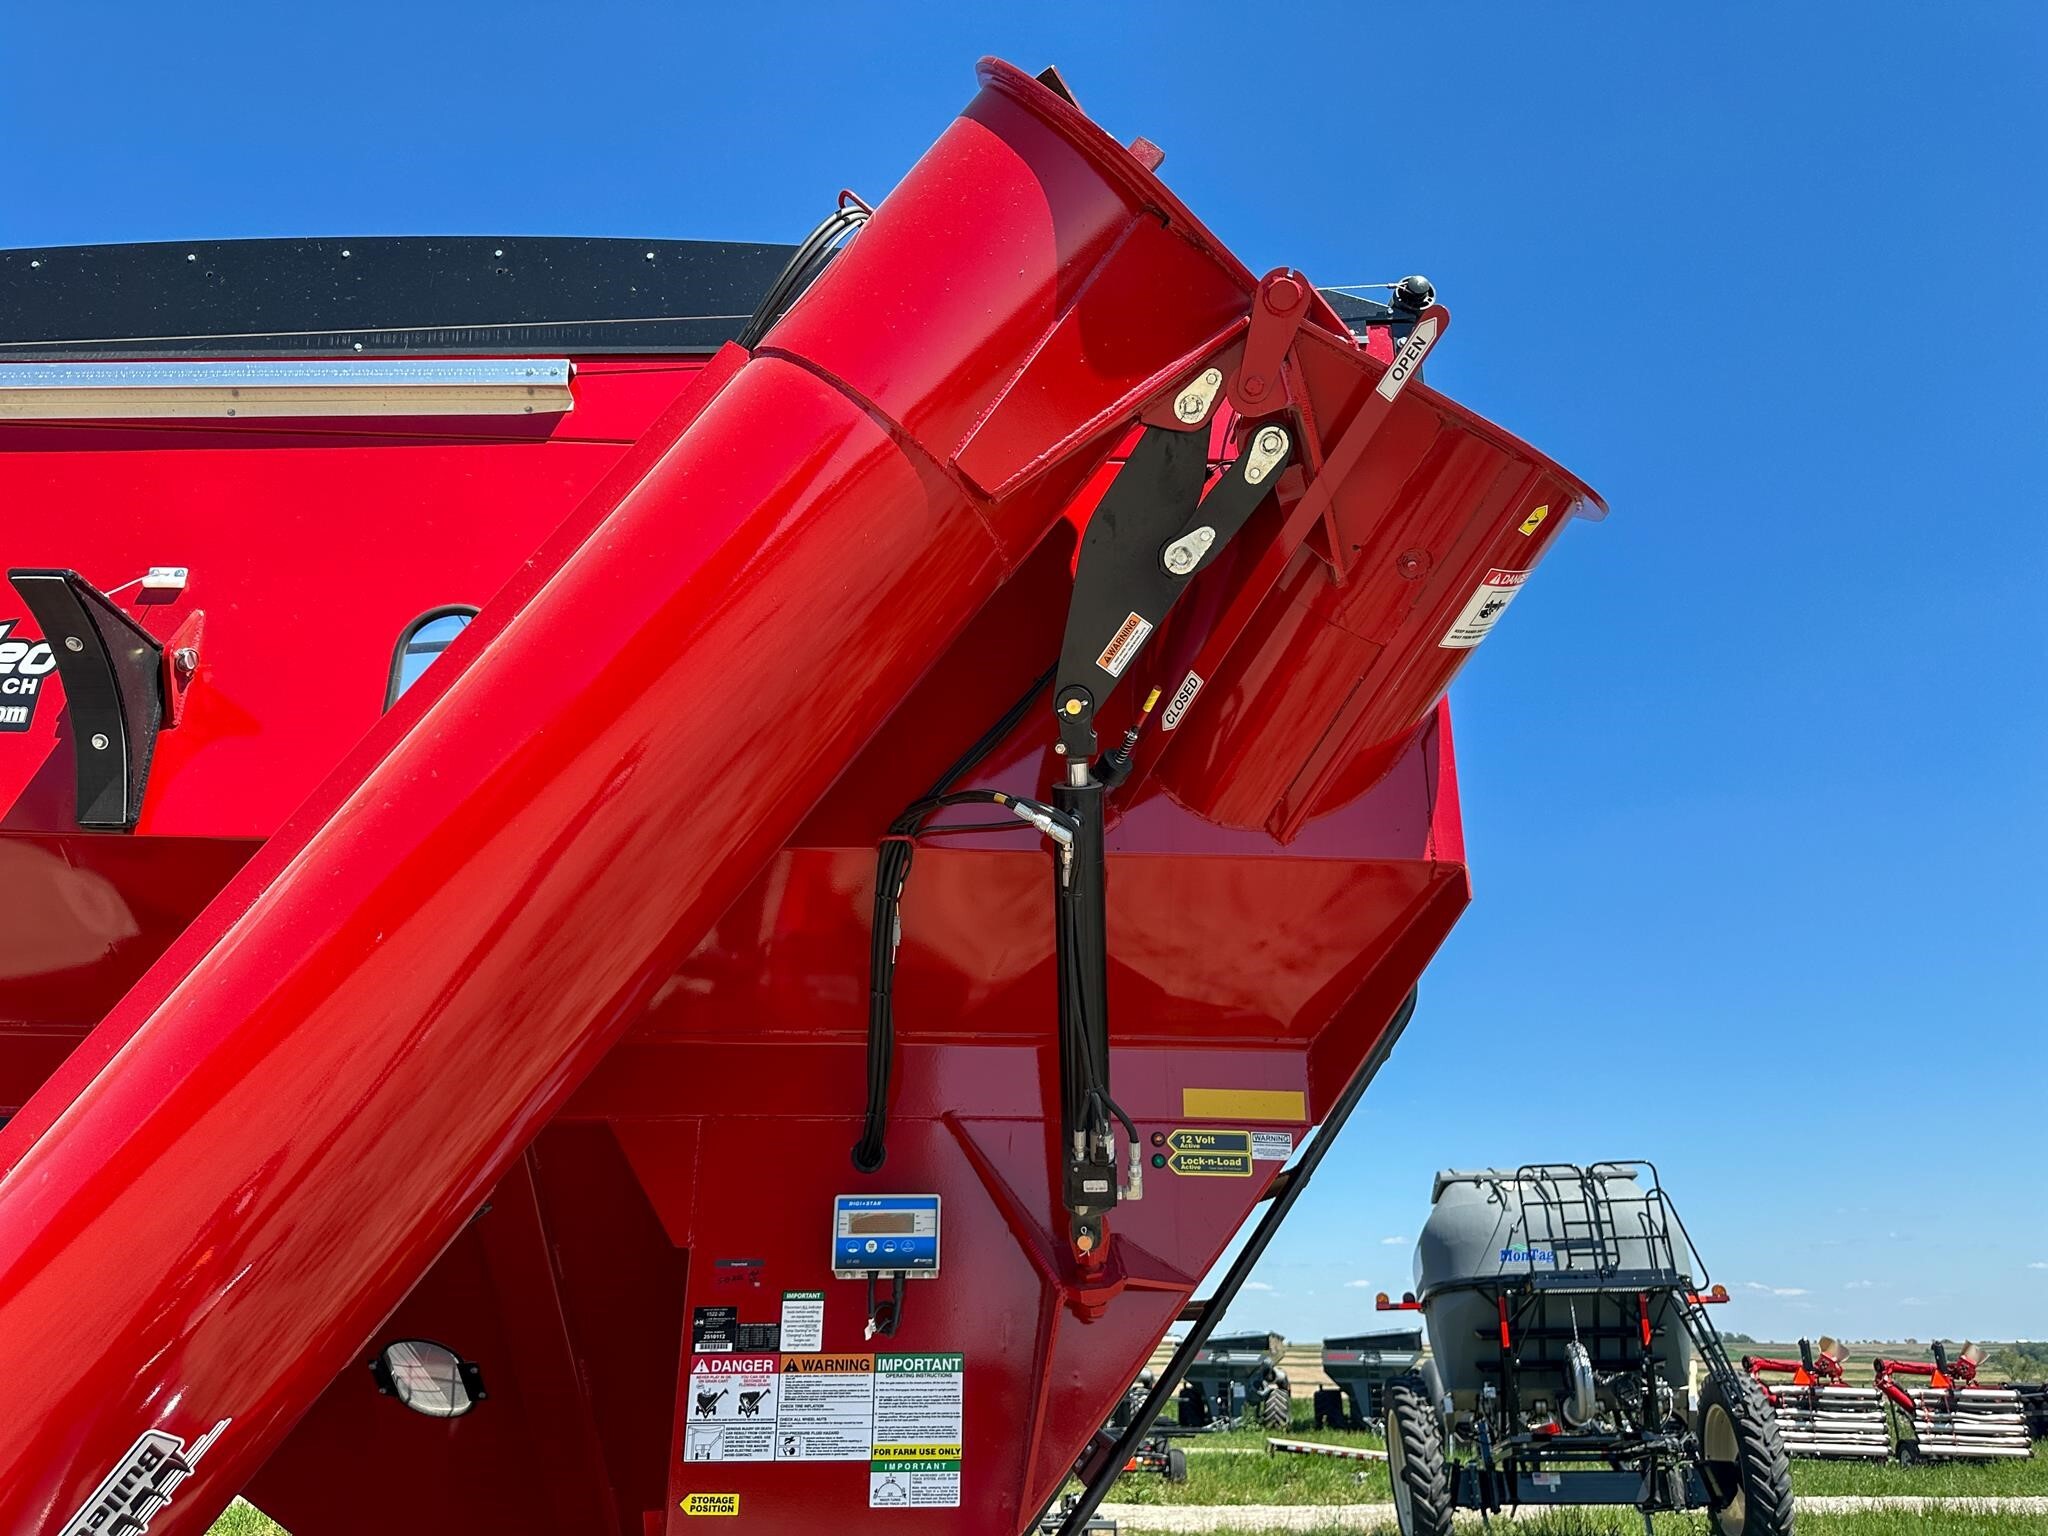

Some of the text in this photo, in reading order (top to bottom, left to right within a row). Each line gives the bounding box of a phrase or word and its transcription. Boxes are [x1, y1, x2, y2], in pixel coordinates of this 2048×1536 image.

[1392, 335, 1427, 381] OPEN
[1107, 619, 1138, 656] WARNING
[1165, 677, 1199, 725] CLOSED
[1180, 1135, 1215, 1145] 12 Volt
[1254, 1135, 1290, 1143] WARNING
[1180, 1157, 1242, 1167] Lock-n-Load
[1499, 1248, 1554, 1263] MonTag
[711, 1359, 774, 1372] DANGER
[801, 1359, 870, 1372] WARNING
[877, 1358, 962, 1371] IMPORTANT
[873, 1448, 961, 1456] FOR FARM USE ONLY
[884, 1462, 947, 1471] IMPORTANT
[691, 1496, 735, 1504] STORAGE
[690, 1504, 735, 1513] POSITION
